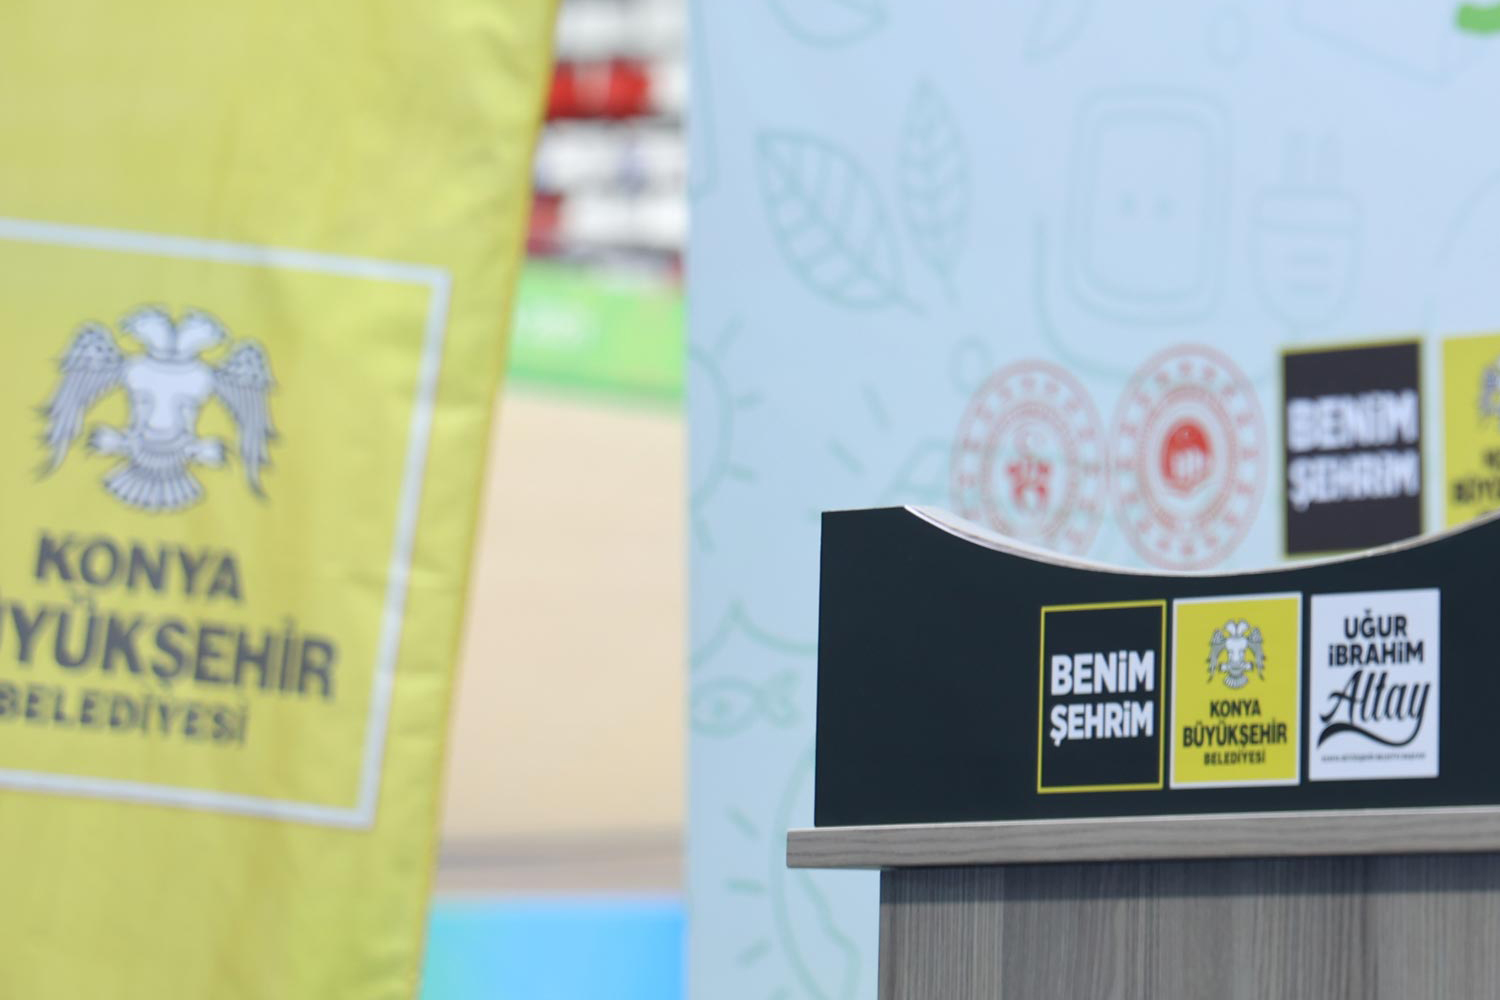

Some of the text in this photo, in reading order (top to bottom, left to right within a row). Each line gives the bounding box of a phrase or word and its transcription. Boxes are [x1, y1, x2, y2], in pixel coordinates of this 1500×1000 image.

[36, 533, 243, 600] KONYA
[1344, 609, 1407, 639] UĞUR
[0, 589, 336, 700] YÜKŞEHİR
[1328, 641, 1424, 667] İBRAHİM
[1051, 650, 1155, 696] BENİM
[1050, 701, 1154, 747] ŞEHRİM
[1210, 699, 1261, 718] KONYA
[1317, 669, 1430, 748] Altay
[1183, 718, 1287, 748] BÜYÜKŞEHİR
[1204, 749, 1265, 765] BELEDİYESİ
